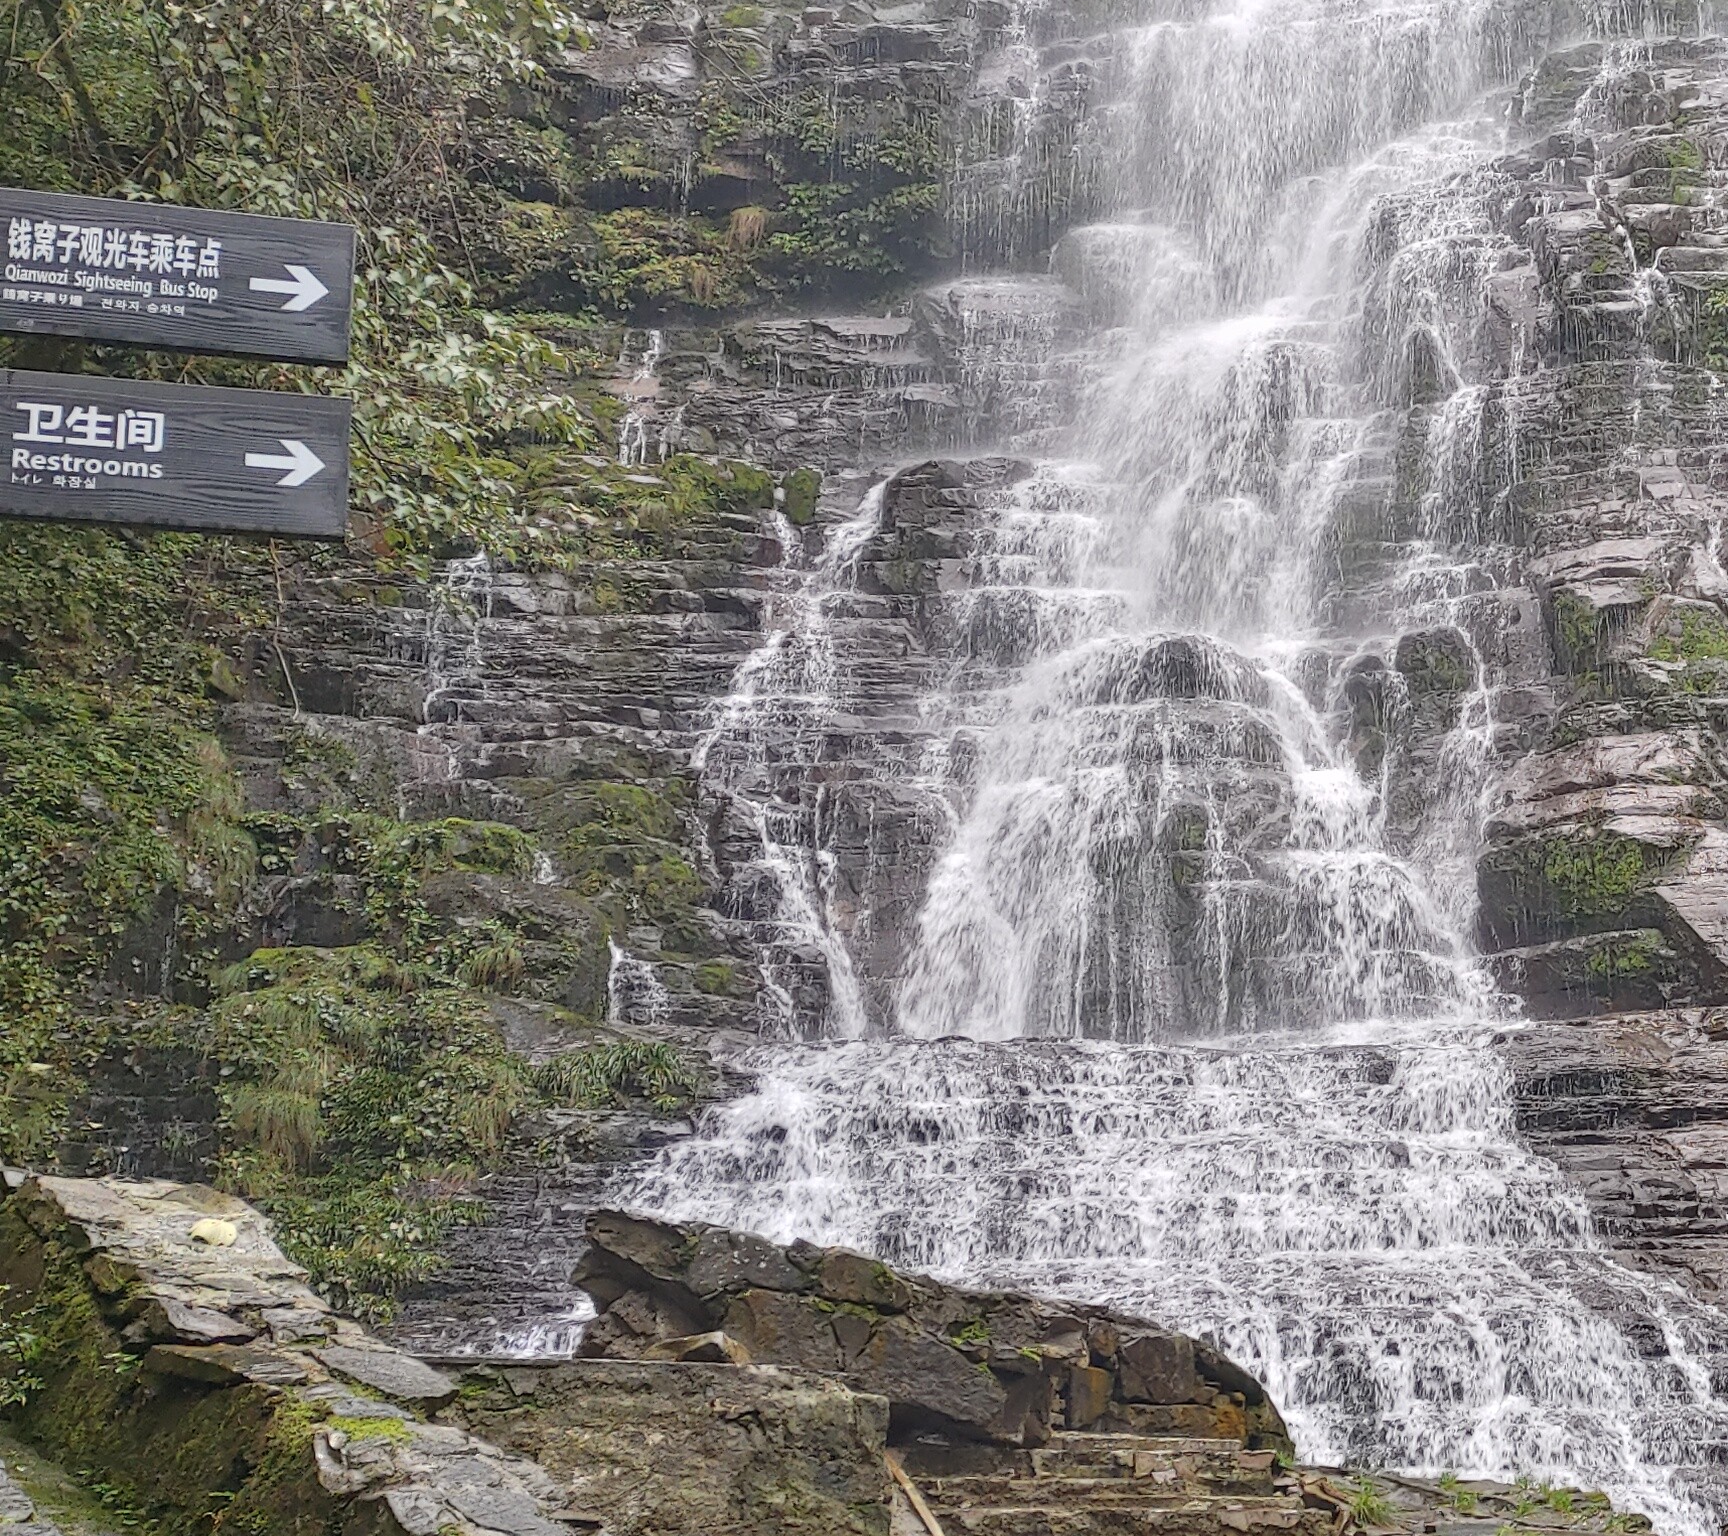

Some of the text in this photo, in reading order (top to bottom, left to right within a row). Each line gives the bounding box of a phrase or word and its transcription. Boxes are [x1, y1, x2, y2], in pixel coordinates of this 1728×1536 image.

[8, 217, 222, 279] 钱窝子观光车乘车点
[5, 263, 218, 304] Qianwozi Sightseeing Bus Stop
[12, 401, 165, 453] 卫生间
[11, 448, 164, 479] Restrooms
[11, 472, 43, 485] トイレ
[52, 474, 97, 490] 화장실
